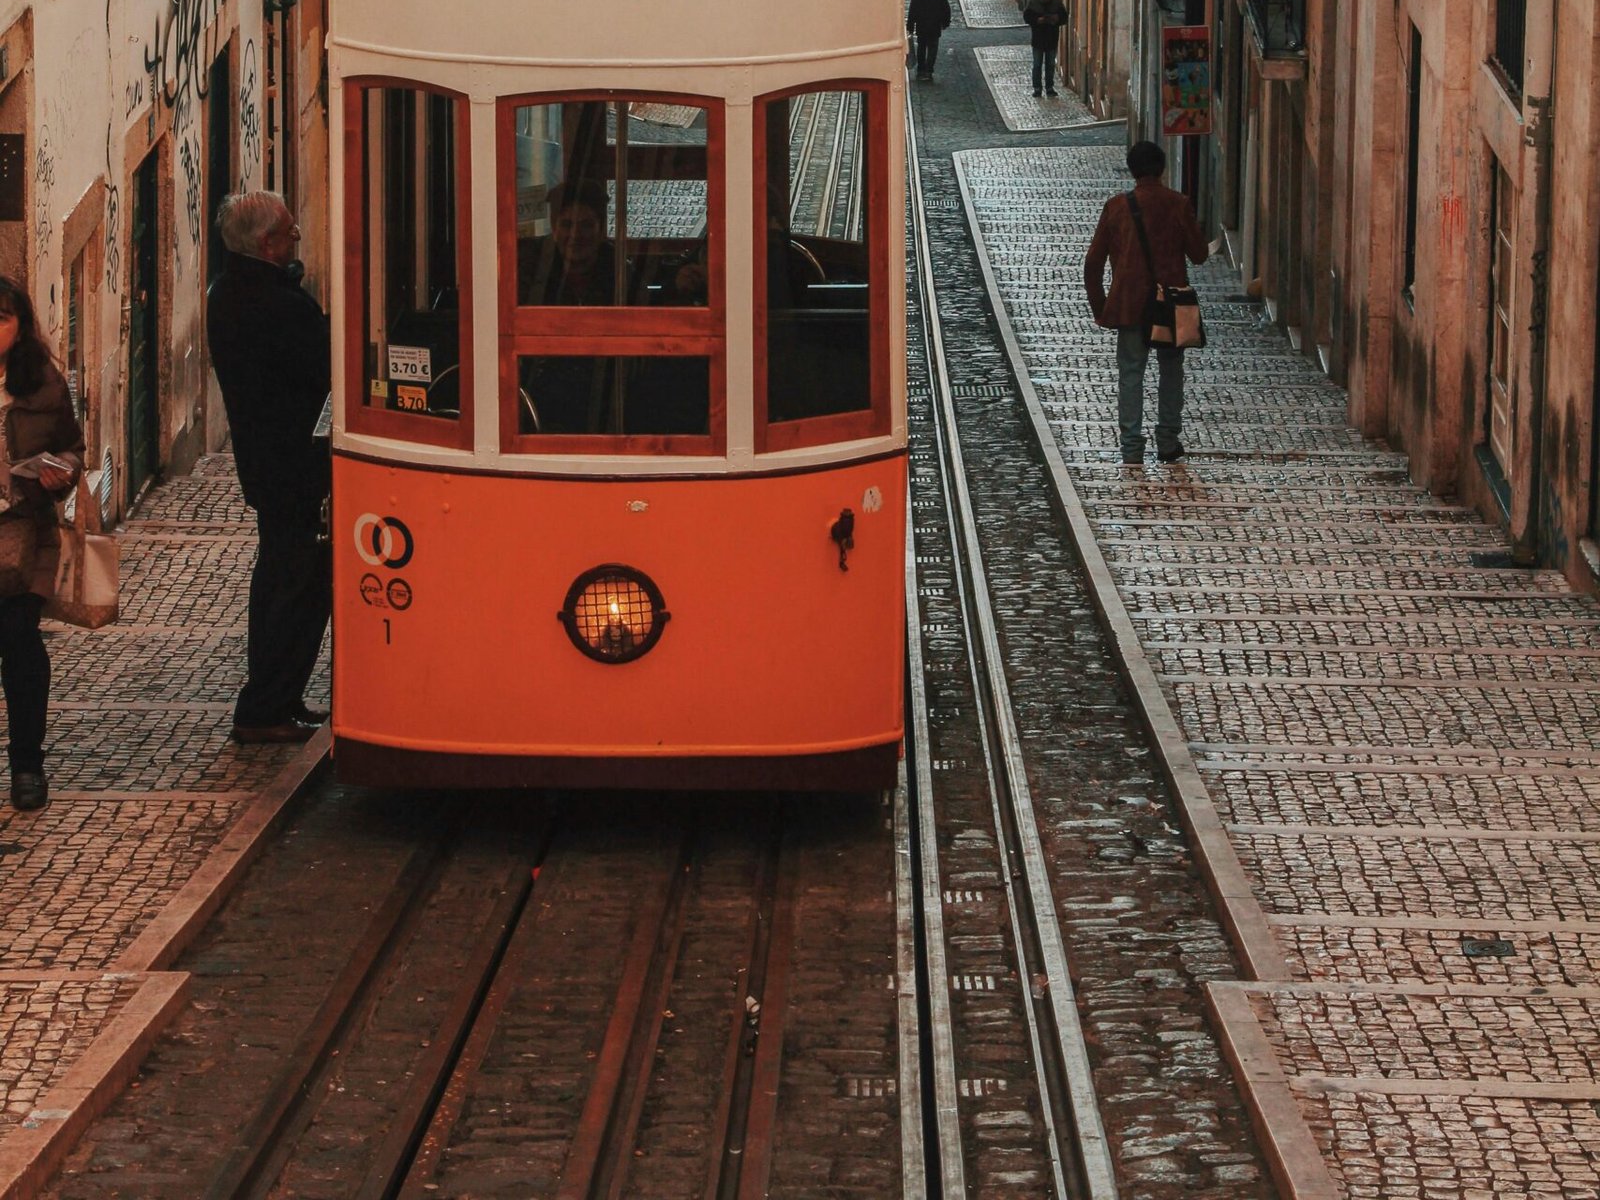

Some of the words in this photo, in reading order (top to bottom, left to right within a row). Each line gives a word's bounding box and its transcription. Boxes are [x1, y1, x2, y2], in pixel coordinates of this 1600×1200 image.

[391, 362, 417, 374] 3.70
[421, 364, 429, 375] €
[383, 618, 391, 645] 1
